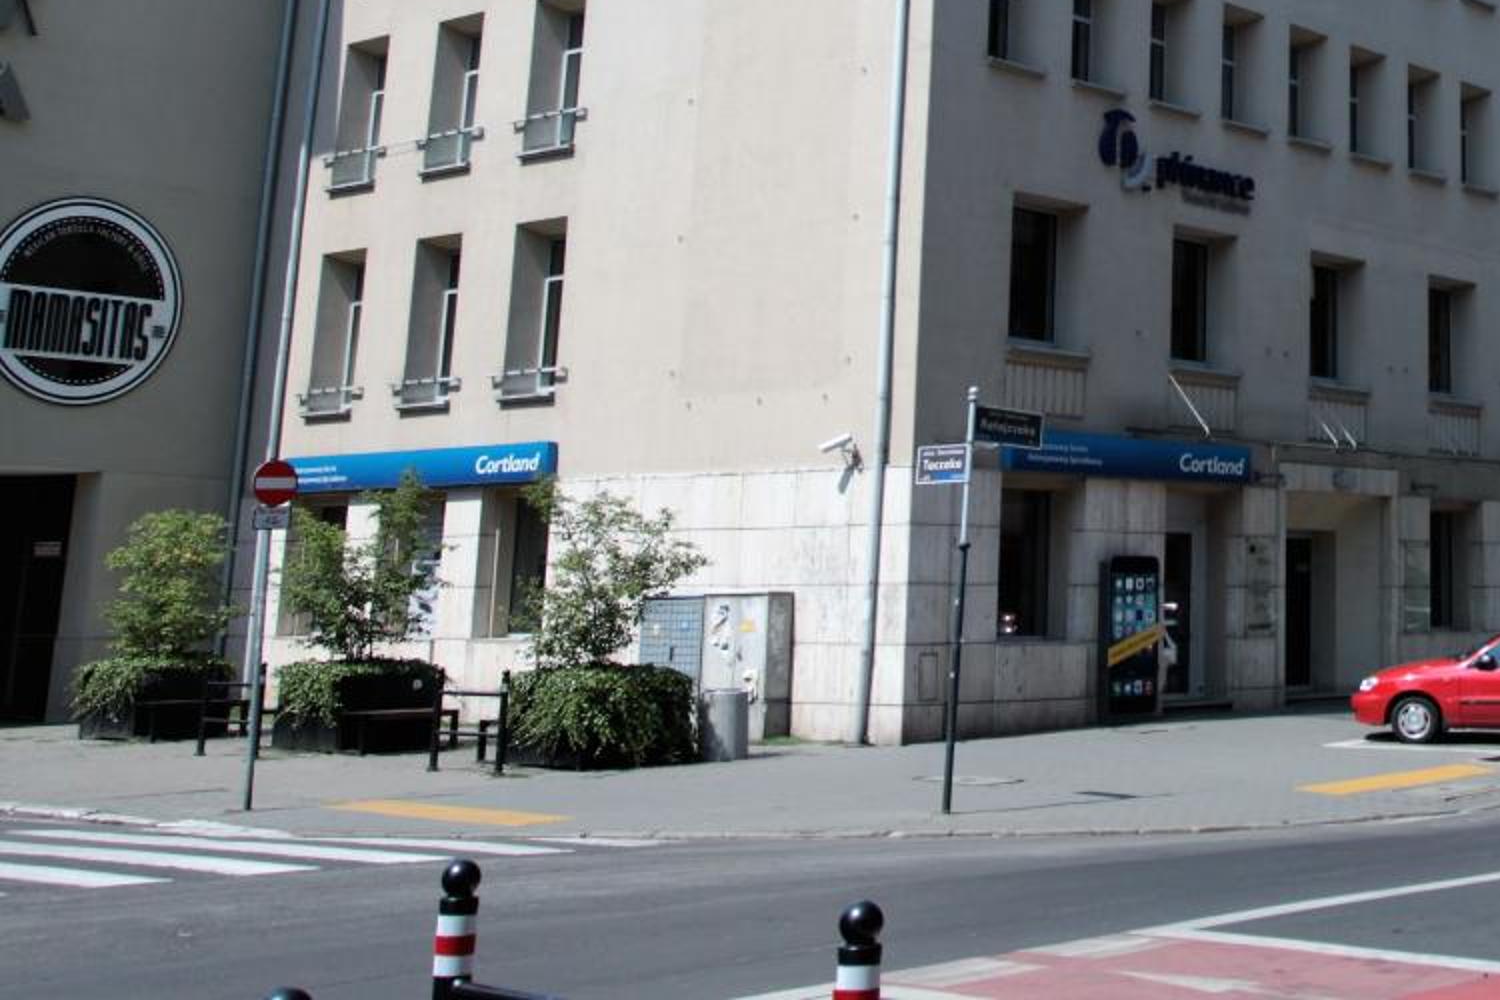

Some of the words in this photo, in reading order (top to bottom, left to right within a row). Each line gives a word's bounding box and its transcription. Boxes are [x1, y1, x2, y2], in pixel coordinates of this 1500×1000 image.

[3, 287, 153, 361] MAMASITAS
[475, 452, 541, 476] Cortland
[1178, 452, 1245, 476] Cortland
